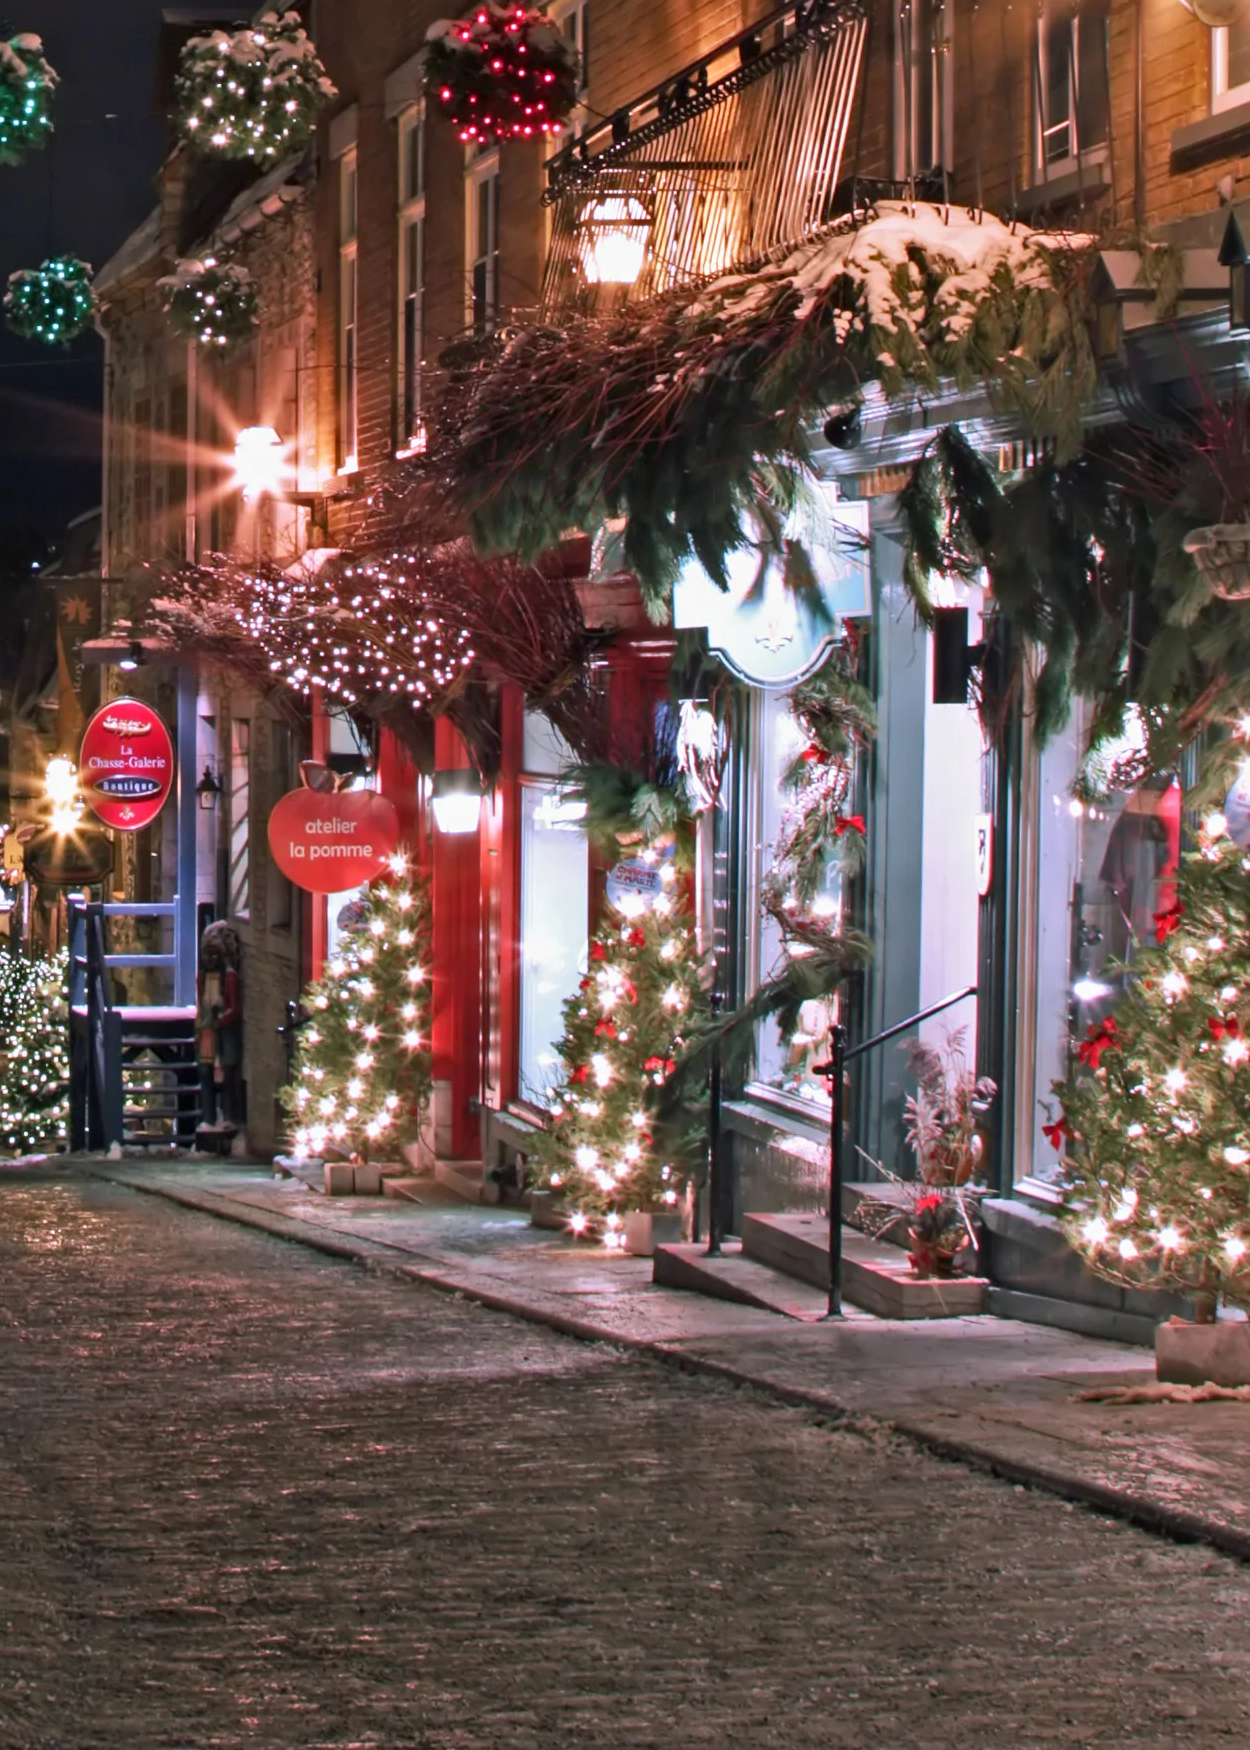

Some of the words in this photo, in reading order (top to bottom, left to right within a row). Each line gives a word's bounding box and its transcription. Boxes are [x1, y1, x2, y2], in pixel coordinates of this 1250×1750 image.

[120, 745, 132, 755] La
[88, 755, 166, 769] Chasse-Galerie
[102, 781, 154, 794] Boutique
[305, 817, 358, 834] atelier
[290, 841, 305, 858] la
[310, 845, 373, 860] pomme
